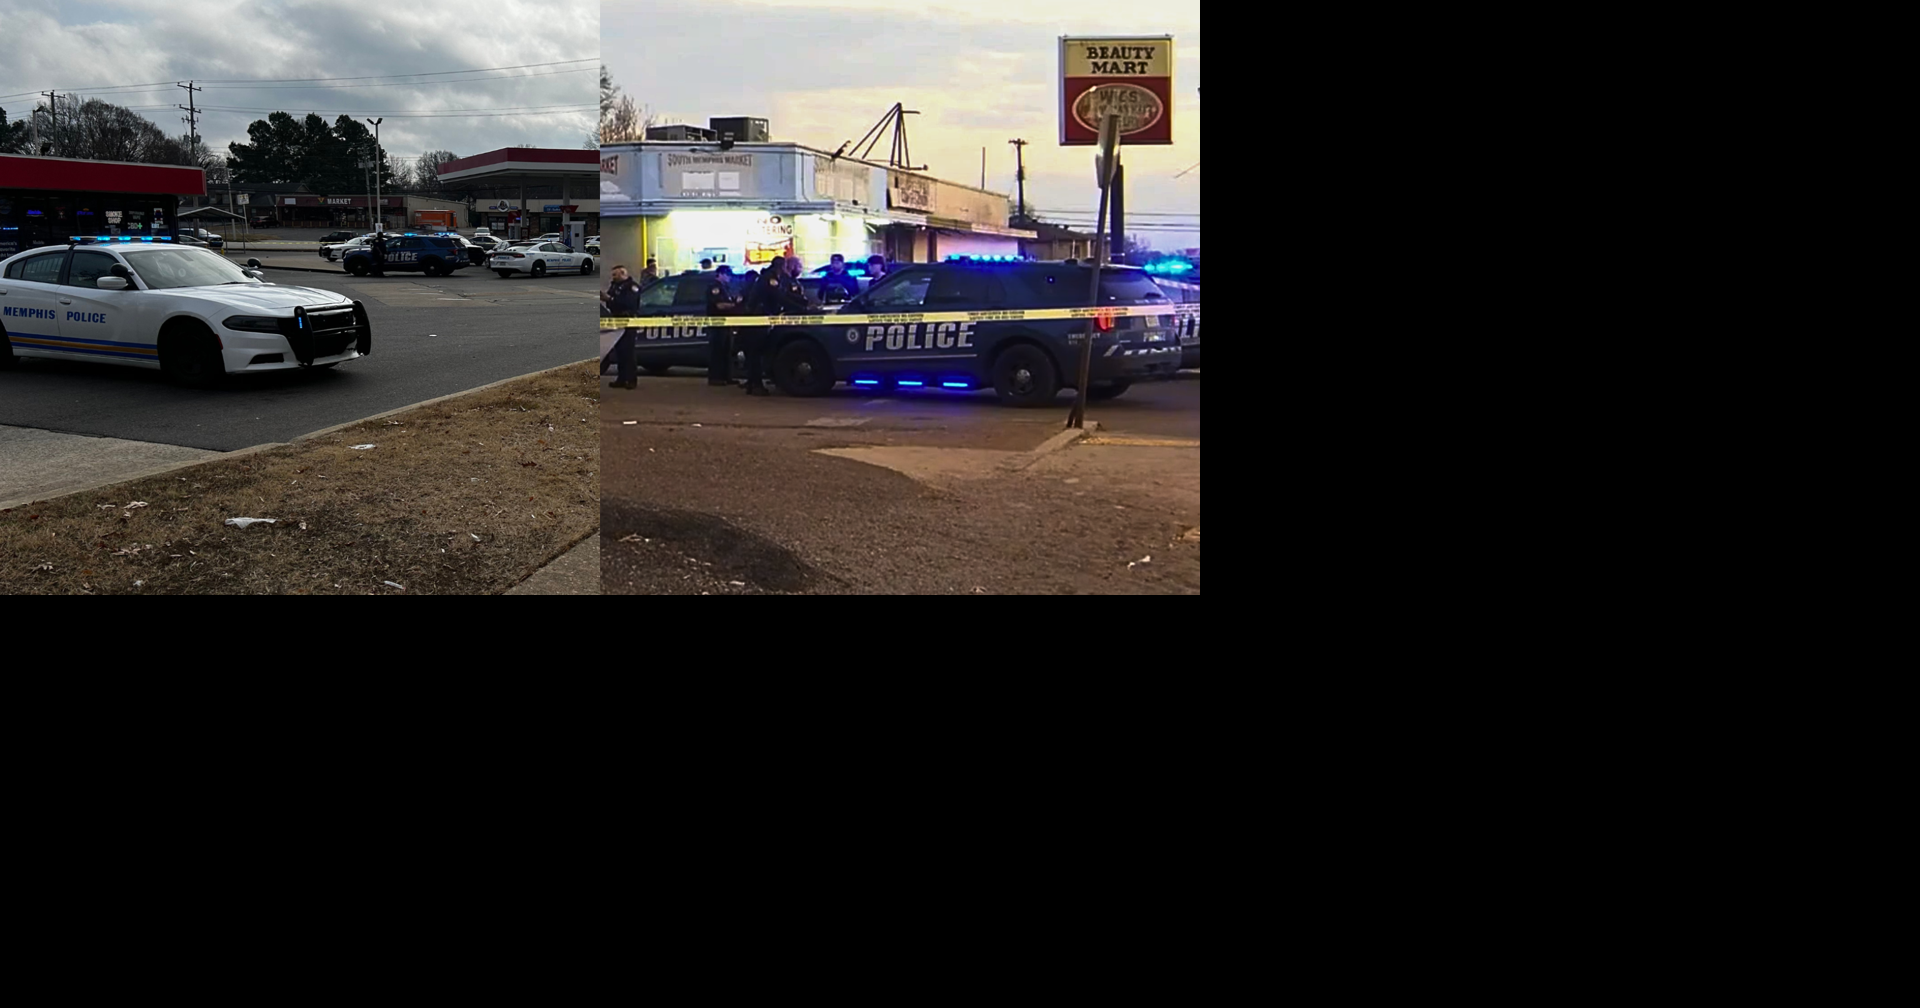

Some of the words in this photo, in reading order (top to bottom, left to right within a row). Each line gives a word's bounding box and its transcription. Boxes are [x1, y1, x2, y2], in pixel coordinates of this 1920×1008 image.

[1086, 46, 1155, 60] BEAUTY
[1091, 62, 1148, 74] MART
[600, 154, 619, 175] RKET
[667, 153, 692, 167] SOUTH
[724, 154, 753, 167] MARKET
[746, 224, 793, 236] LTERING
[3, 306, 56, 320] MEMPHIS
[66, 311, 107, 324] POLICE
[865, 322, 978, 351] POLICE
